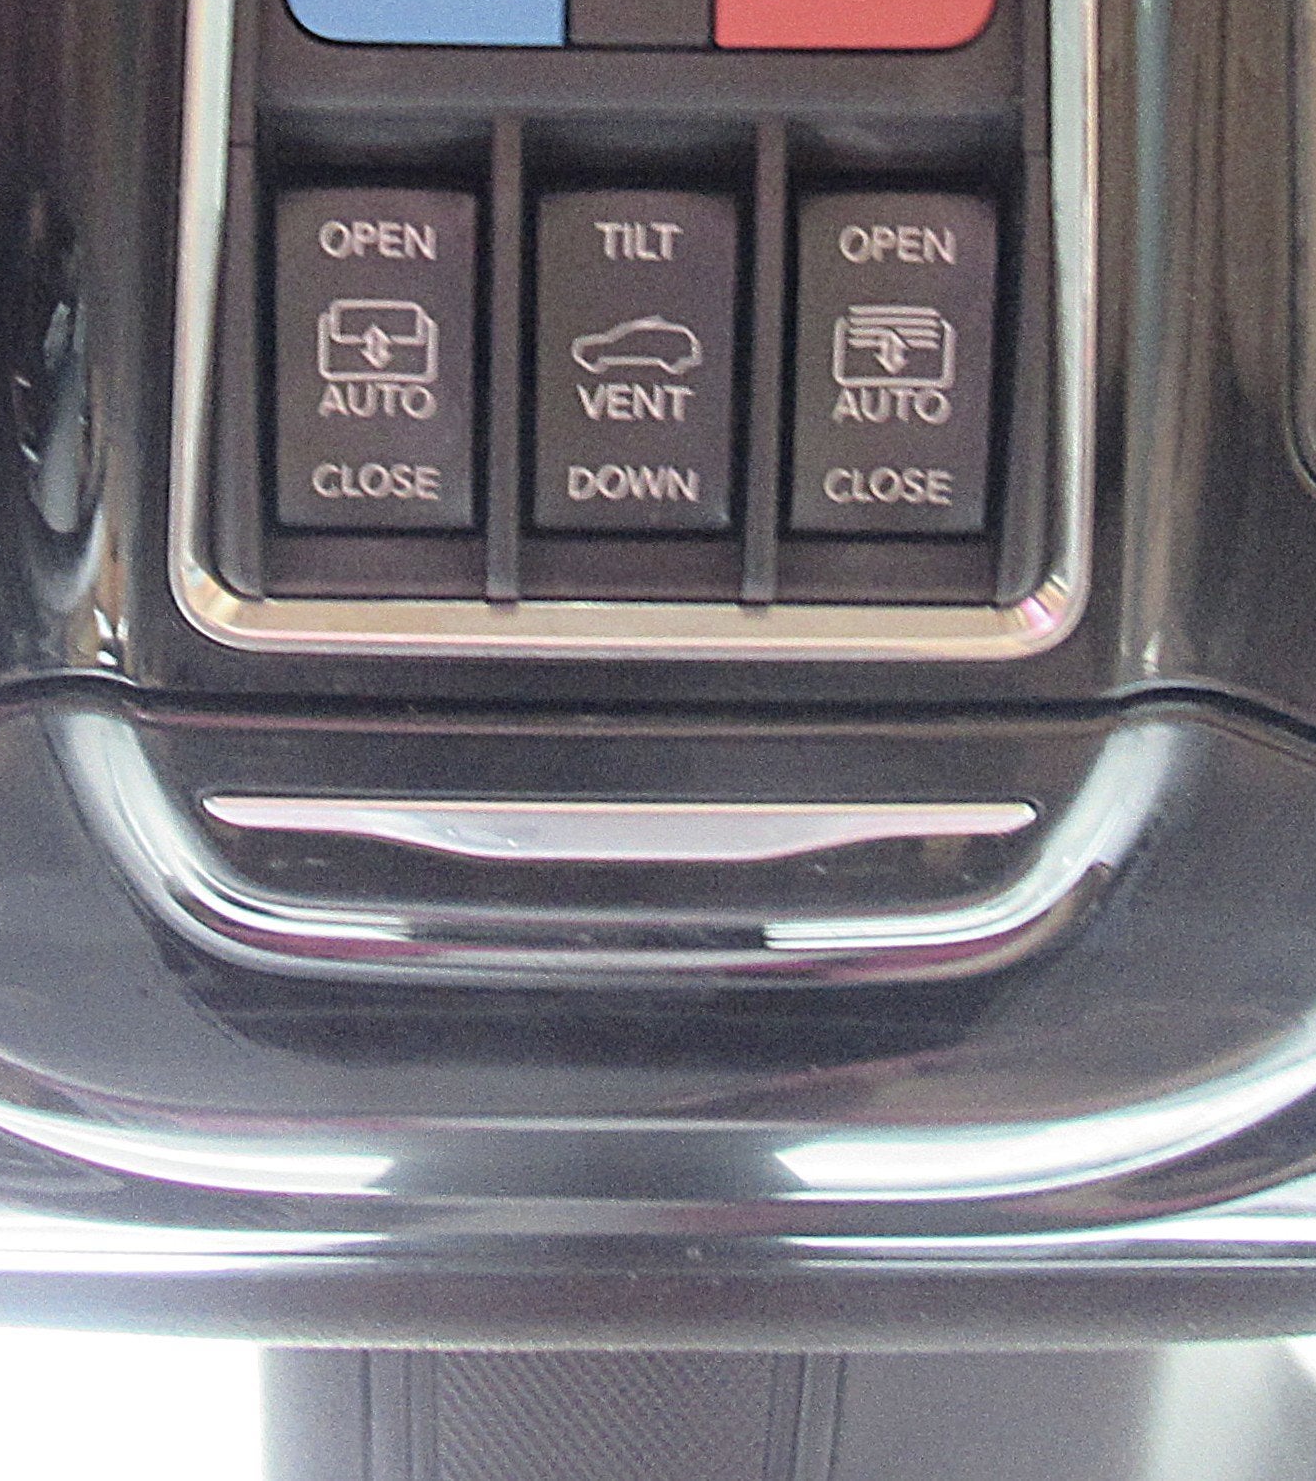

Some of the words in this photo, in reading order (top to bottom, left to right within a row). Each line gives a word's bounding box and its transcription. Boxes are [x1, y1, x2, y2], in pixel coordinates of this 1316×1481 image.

[320, 221, 436, 261] OPEN
[594, 221, 683, 262] TILT
[840, 224, 957, 265] OPEN
[319, 384, 436, 420] AUTO
[576, 384, 693, 423] VENT
[833, 387, 953, 425] AUTO
[312, 463, 440, 501] CLOSE
[568, 464, 700, 503] DOWN
[823, 467, 953, 506] CLOSE
